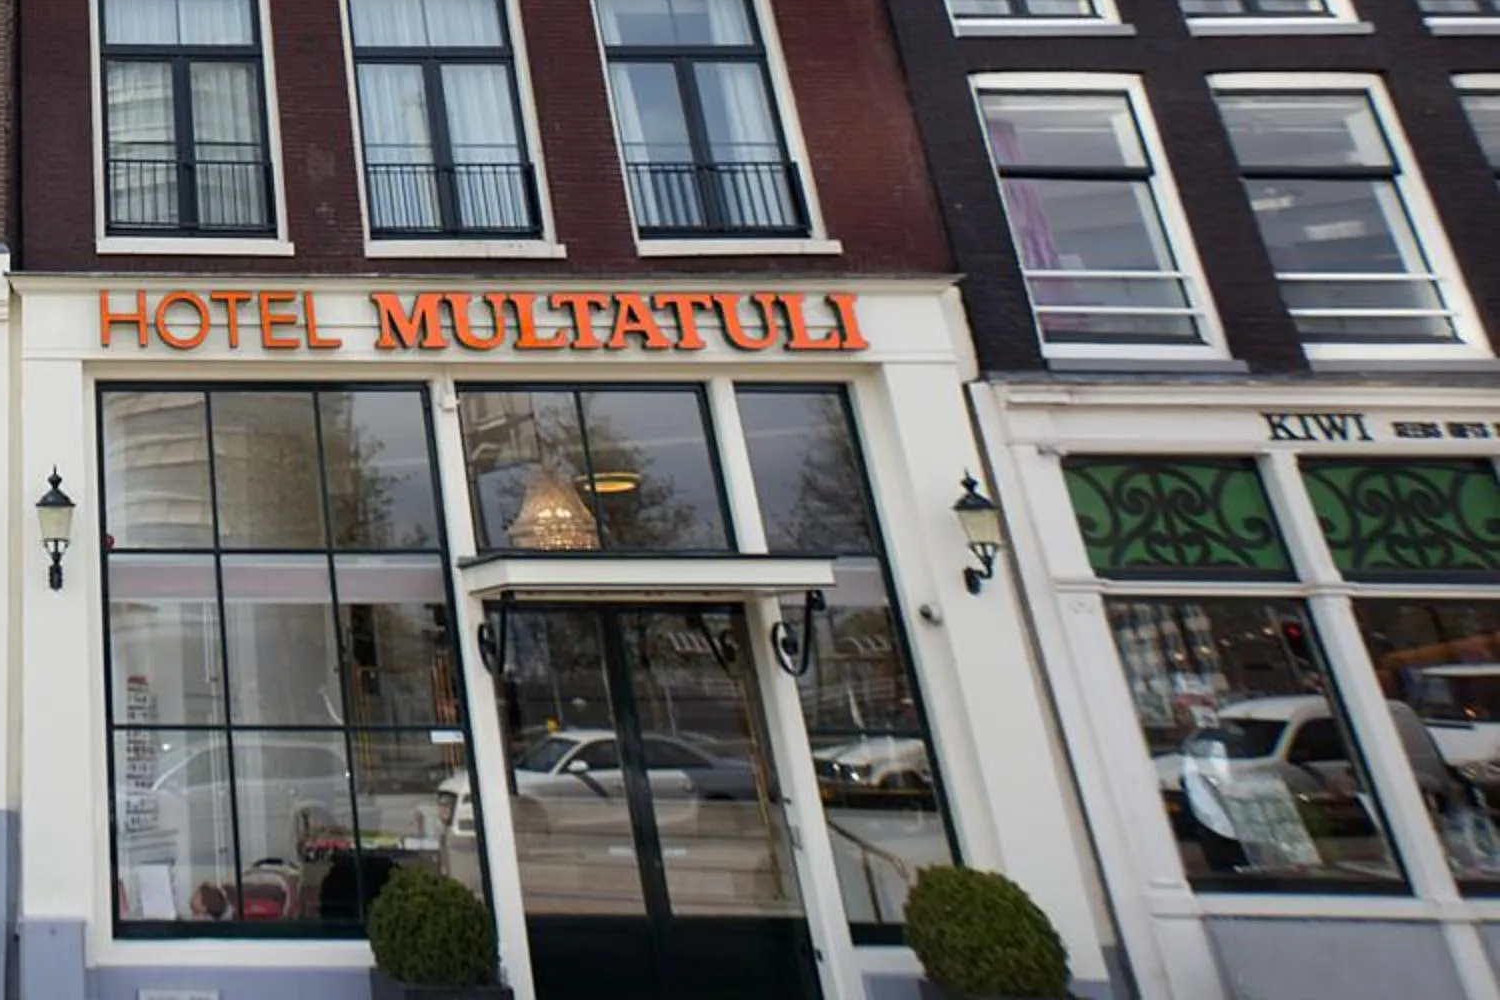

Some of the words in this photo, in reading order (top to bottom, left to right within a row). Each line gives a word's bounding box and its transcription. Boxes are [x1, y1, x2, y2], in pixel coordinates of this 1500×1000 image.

[99, 289, 343, 350] HOTEL
[370, 291, 869, 352] MULTATULI
[1260, 412, 1373, 441] KIWI
